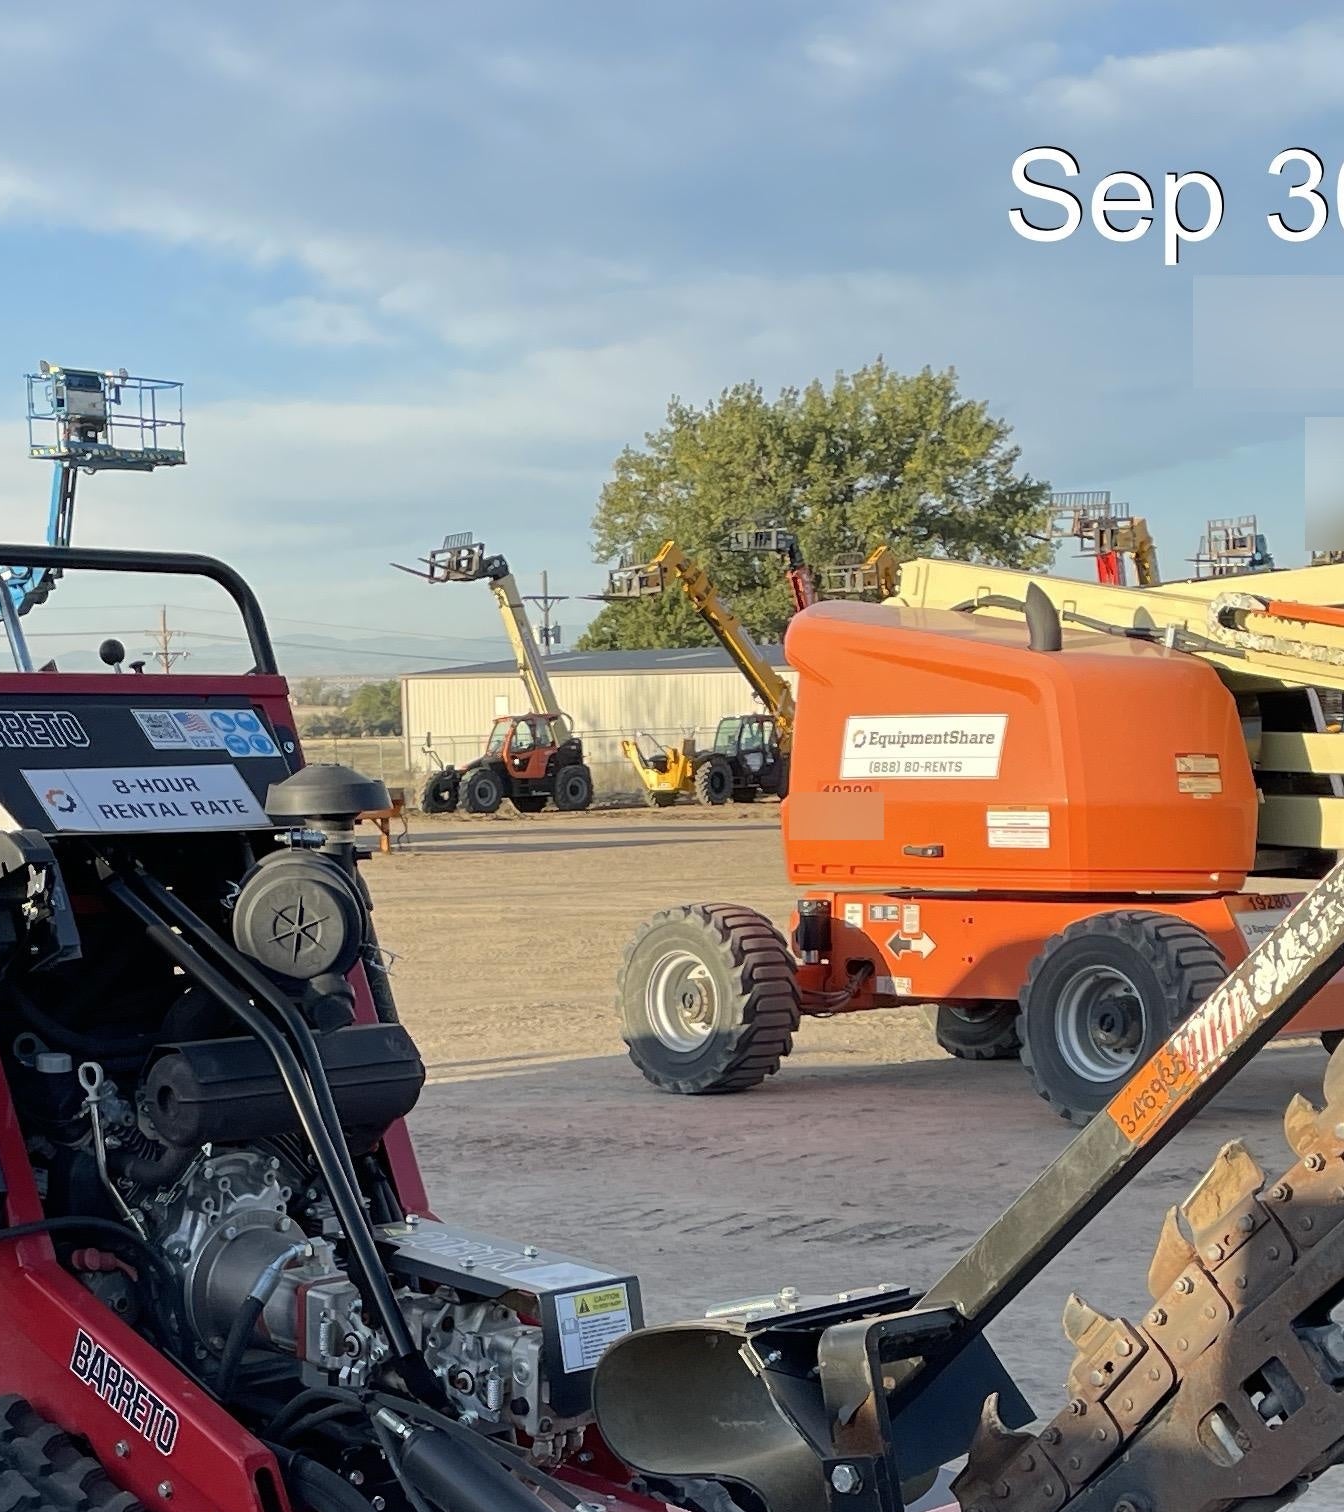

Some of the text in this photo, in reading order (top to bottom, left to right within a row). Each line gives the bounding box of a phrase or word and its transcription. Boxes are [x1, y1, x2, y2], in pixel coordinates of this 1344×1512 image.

[868, 731, 996, 749] EquipmentShare
[869, 760, 963, 773] (888) 80-RENTS
[112, 777, 200, 794] 8-HOUR
[97, 798, 249, 820] RENTAL RATE
[69, 1328, 179, 1456] BARRETO
